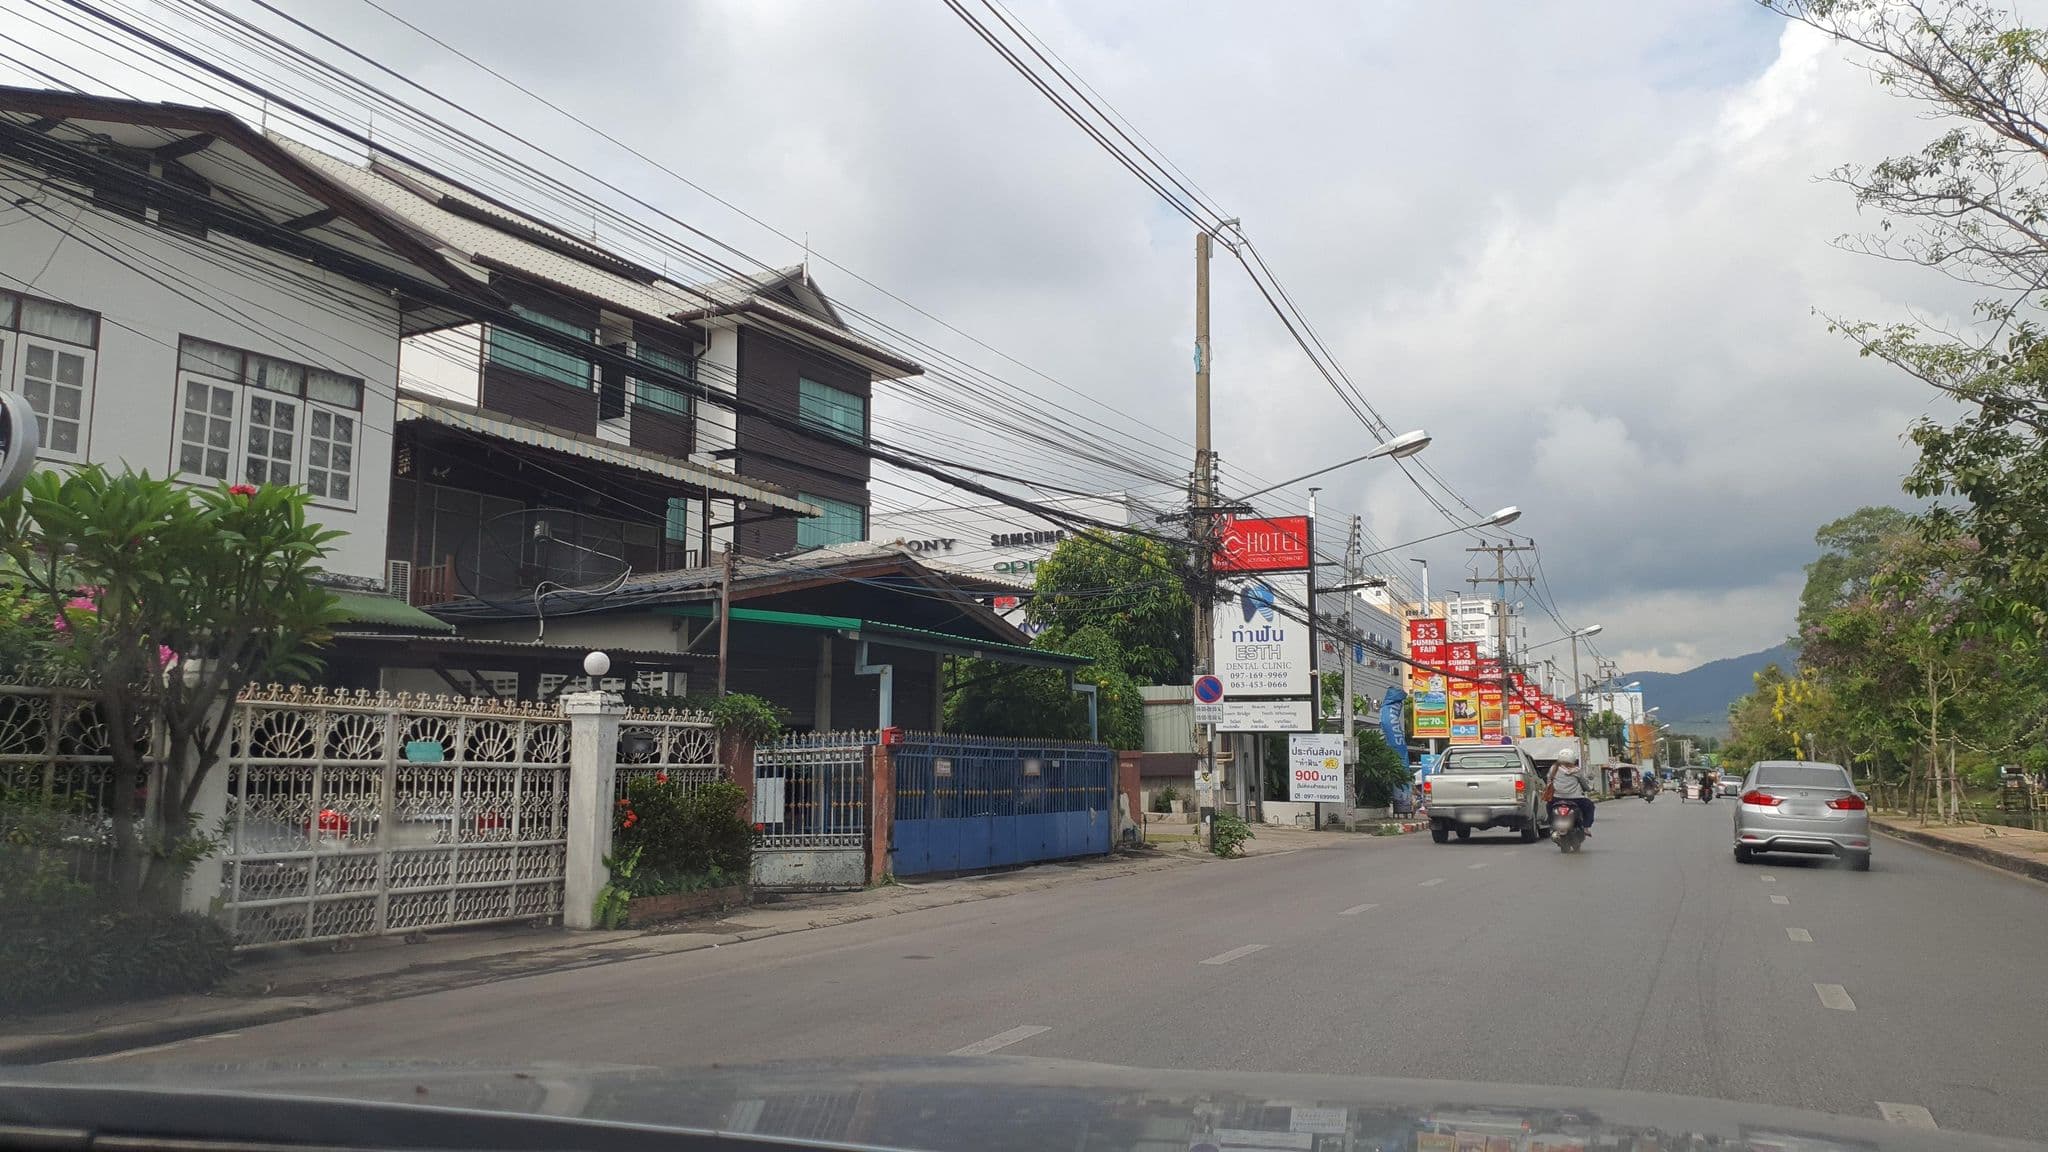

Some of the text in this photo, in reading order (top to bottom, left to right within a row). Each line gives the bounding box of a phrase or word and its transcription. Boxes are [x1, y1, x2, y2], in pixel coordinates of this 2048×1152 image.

[907, 538, 956, 551] ONY
[1247, 531, 1303, 552] HOTEL
[1232, 624, 1284, 642] ทำฟัน
[1235, 644, 1281, 660] ESTH
[1226, 661, 1292, 671] DENTAL CLINIC
[1230, 671, 1288, 679] 097-169-9969
[1291, 746, 1342, 756] ประกันสังคม
[1295, 770, 1338, 782] 900 บาท
